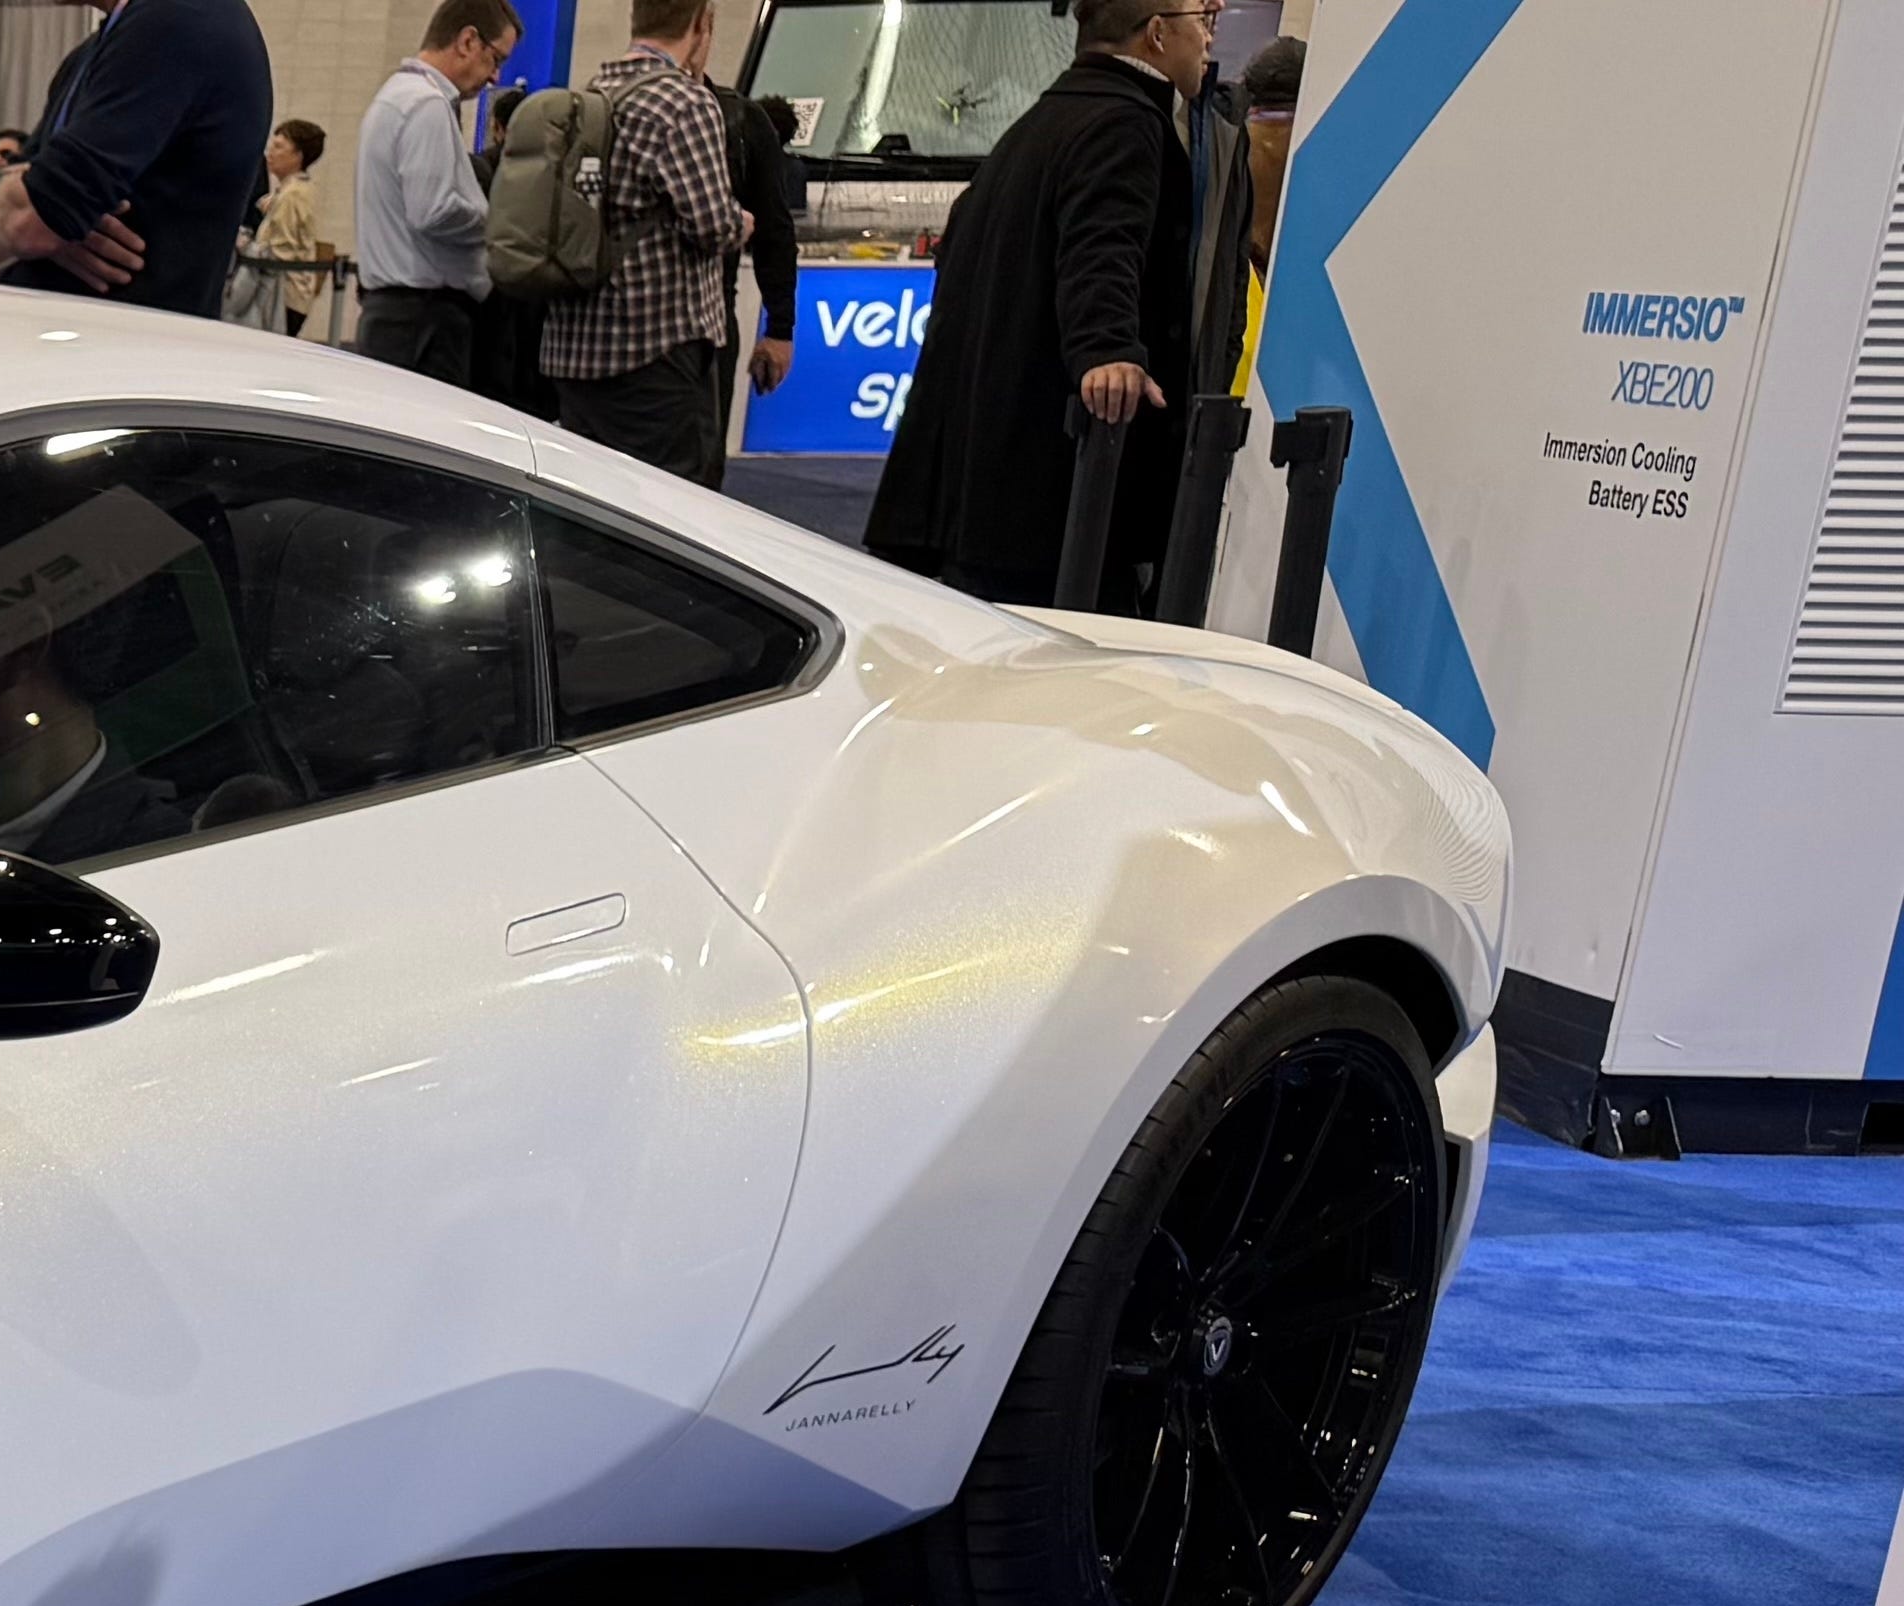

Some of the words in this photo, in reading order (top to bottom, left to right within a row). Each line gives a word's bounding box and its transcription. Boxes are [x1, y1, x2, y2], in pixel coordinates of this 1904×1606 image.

[1611, 360, 1714, 411] XBE200
[1543, 432, 1627, 467] Immersion
[1631, 442, 1697, 482] Cooling
[1588, 480, 1649, 519] Battery
[1652, 489, 1689, 519] ESS
[785, 1400, 916, 1432] JANNARELLY
